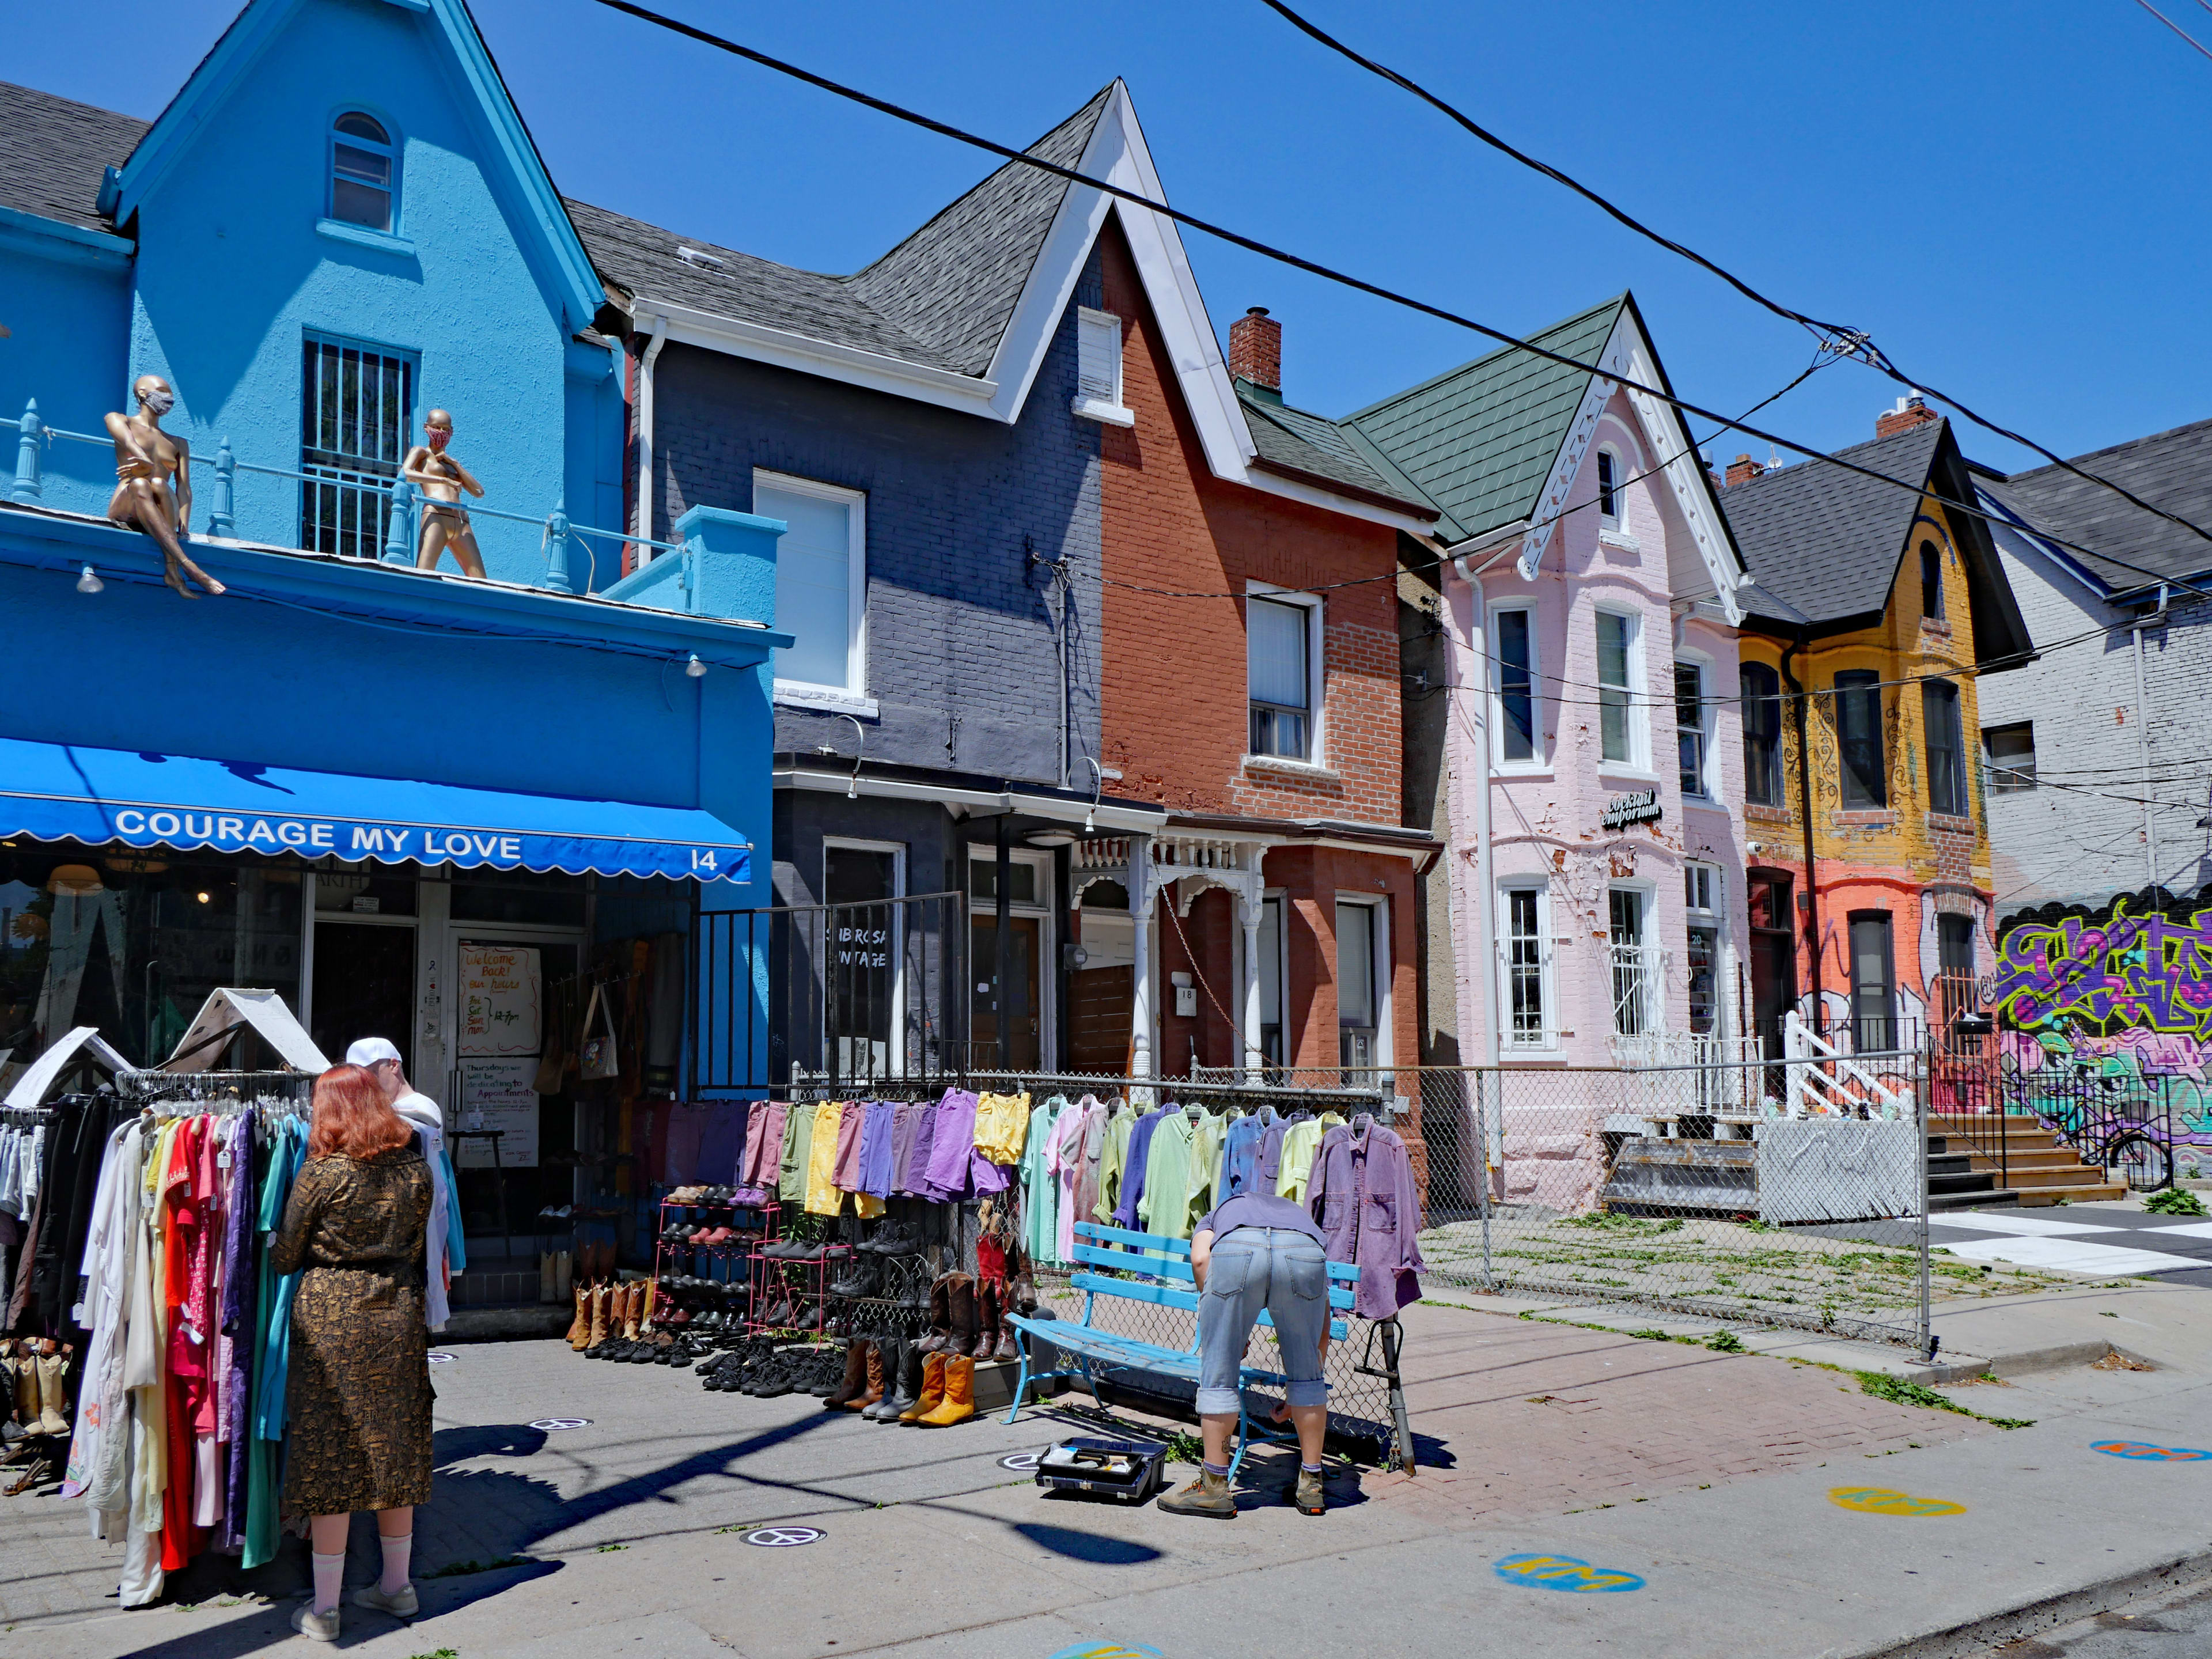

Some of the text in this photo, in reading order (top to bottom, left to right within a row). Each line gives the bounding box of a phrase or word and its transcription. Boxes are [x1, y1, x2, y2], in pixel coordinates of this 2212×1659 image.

[1608, 789, 1652, 812] cocktail
[1601, 804, 1660, 827] emporium
[116, 809, 521, 859] COURAGE MY LOVE
[692, 849, 718, 870] 14
[1691, 934, 1701, 945] 20
[466, 952, 517, 965] Welcome
[482, 966, 510, 976] Back!
[469, 978, 520, 989] our hours
[468, 995, 481, 1005] Fri
[1183, 990, 1192, 999] 18
[467, 1006, 482, 1016] Sat
[467, 1016, 484, 1025] Sun
[467, 1064, 509, 1074] Thursdays
[467, 1079, 522, 1090] dedicating to
[478, 1088, 534, 1099] Appointments
[1834, 1490, 1955, 1515] KM
[1499, 1557, 1637, 1590] KM
